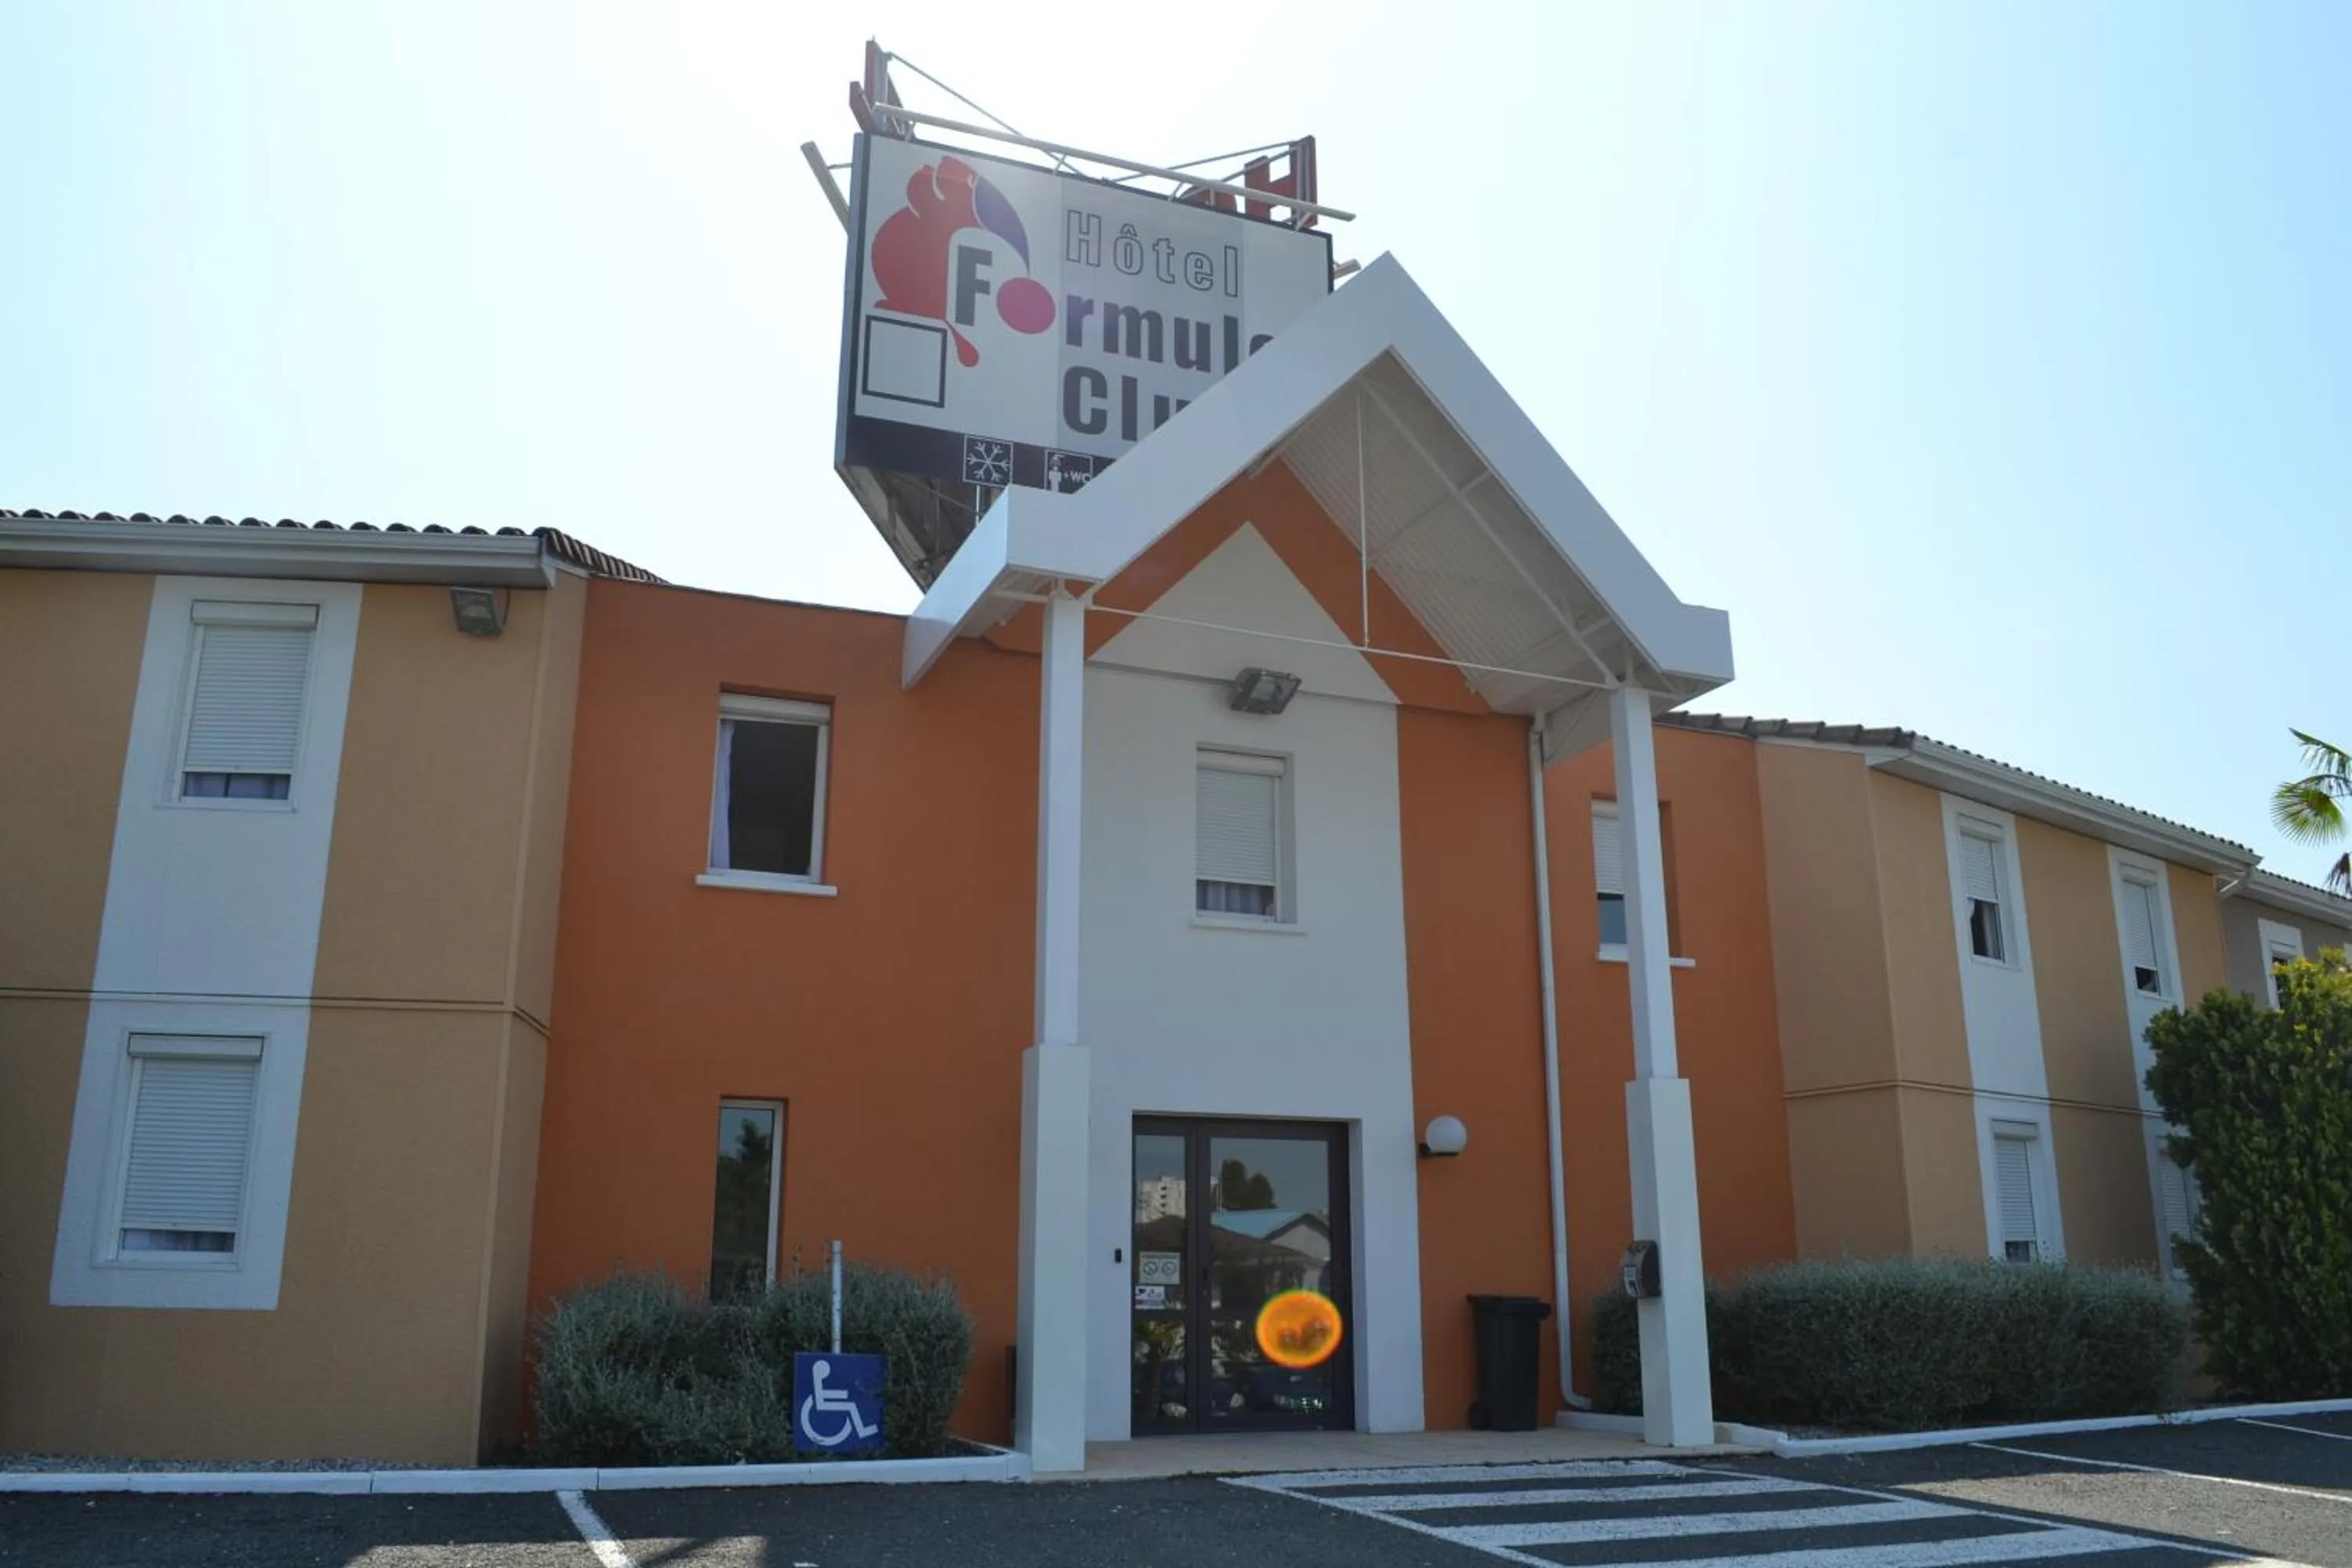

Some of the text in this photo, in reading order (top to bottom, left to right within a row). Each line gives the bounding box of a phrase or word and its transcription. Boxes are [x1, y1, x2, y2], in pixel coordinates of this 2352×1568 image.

[1066, 209, 1239, 298] Hôtel
[955, 245, 1275, 376] Formul
[1062, 365, 1192, 441] Cl
